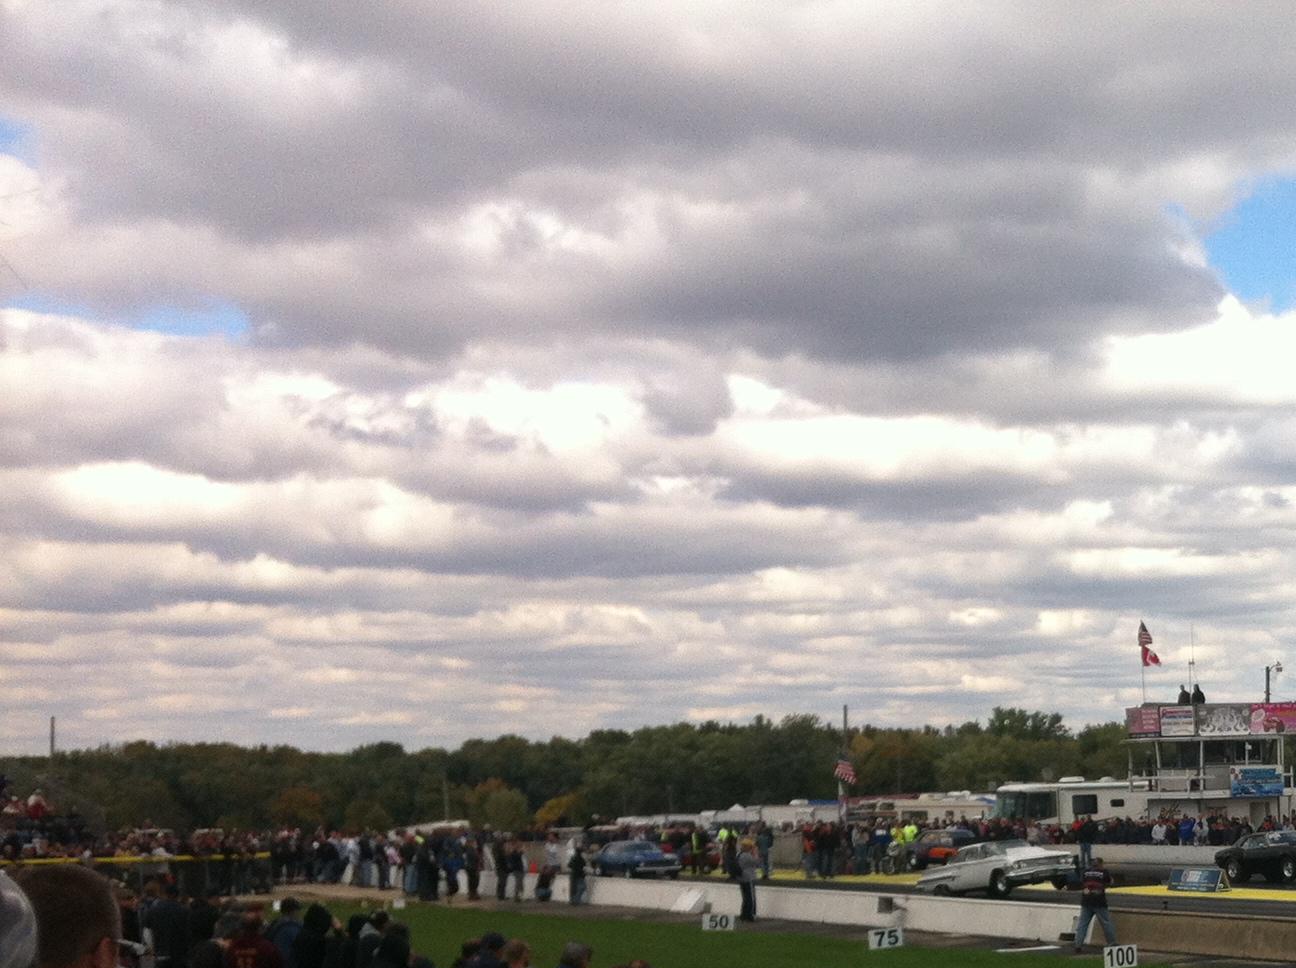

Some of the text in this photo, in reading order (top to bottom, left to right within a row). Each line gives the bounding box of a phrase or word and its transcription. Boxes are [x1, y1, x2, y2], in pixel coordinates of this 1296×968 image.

[709, 915, 728, 928] 50
[874, 929, 899, 947] 75
[1107, 946, 1135, 967] 100
